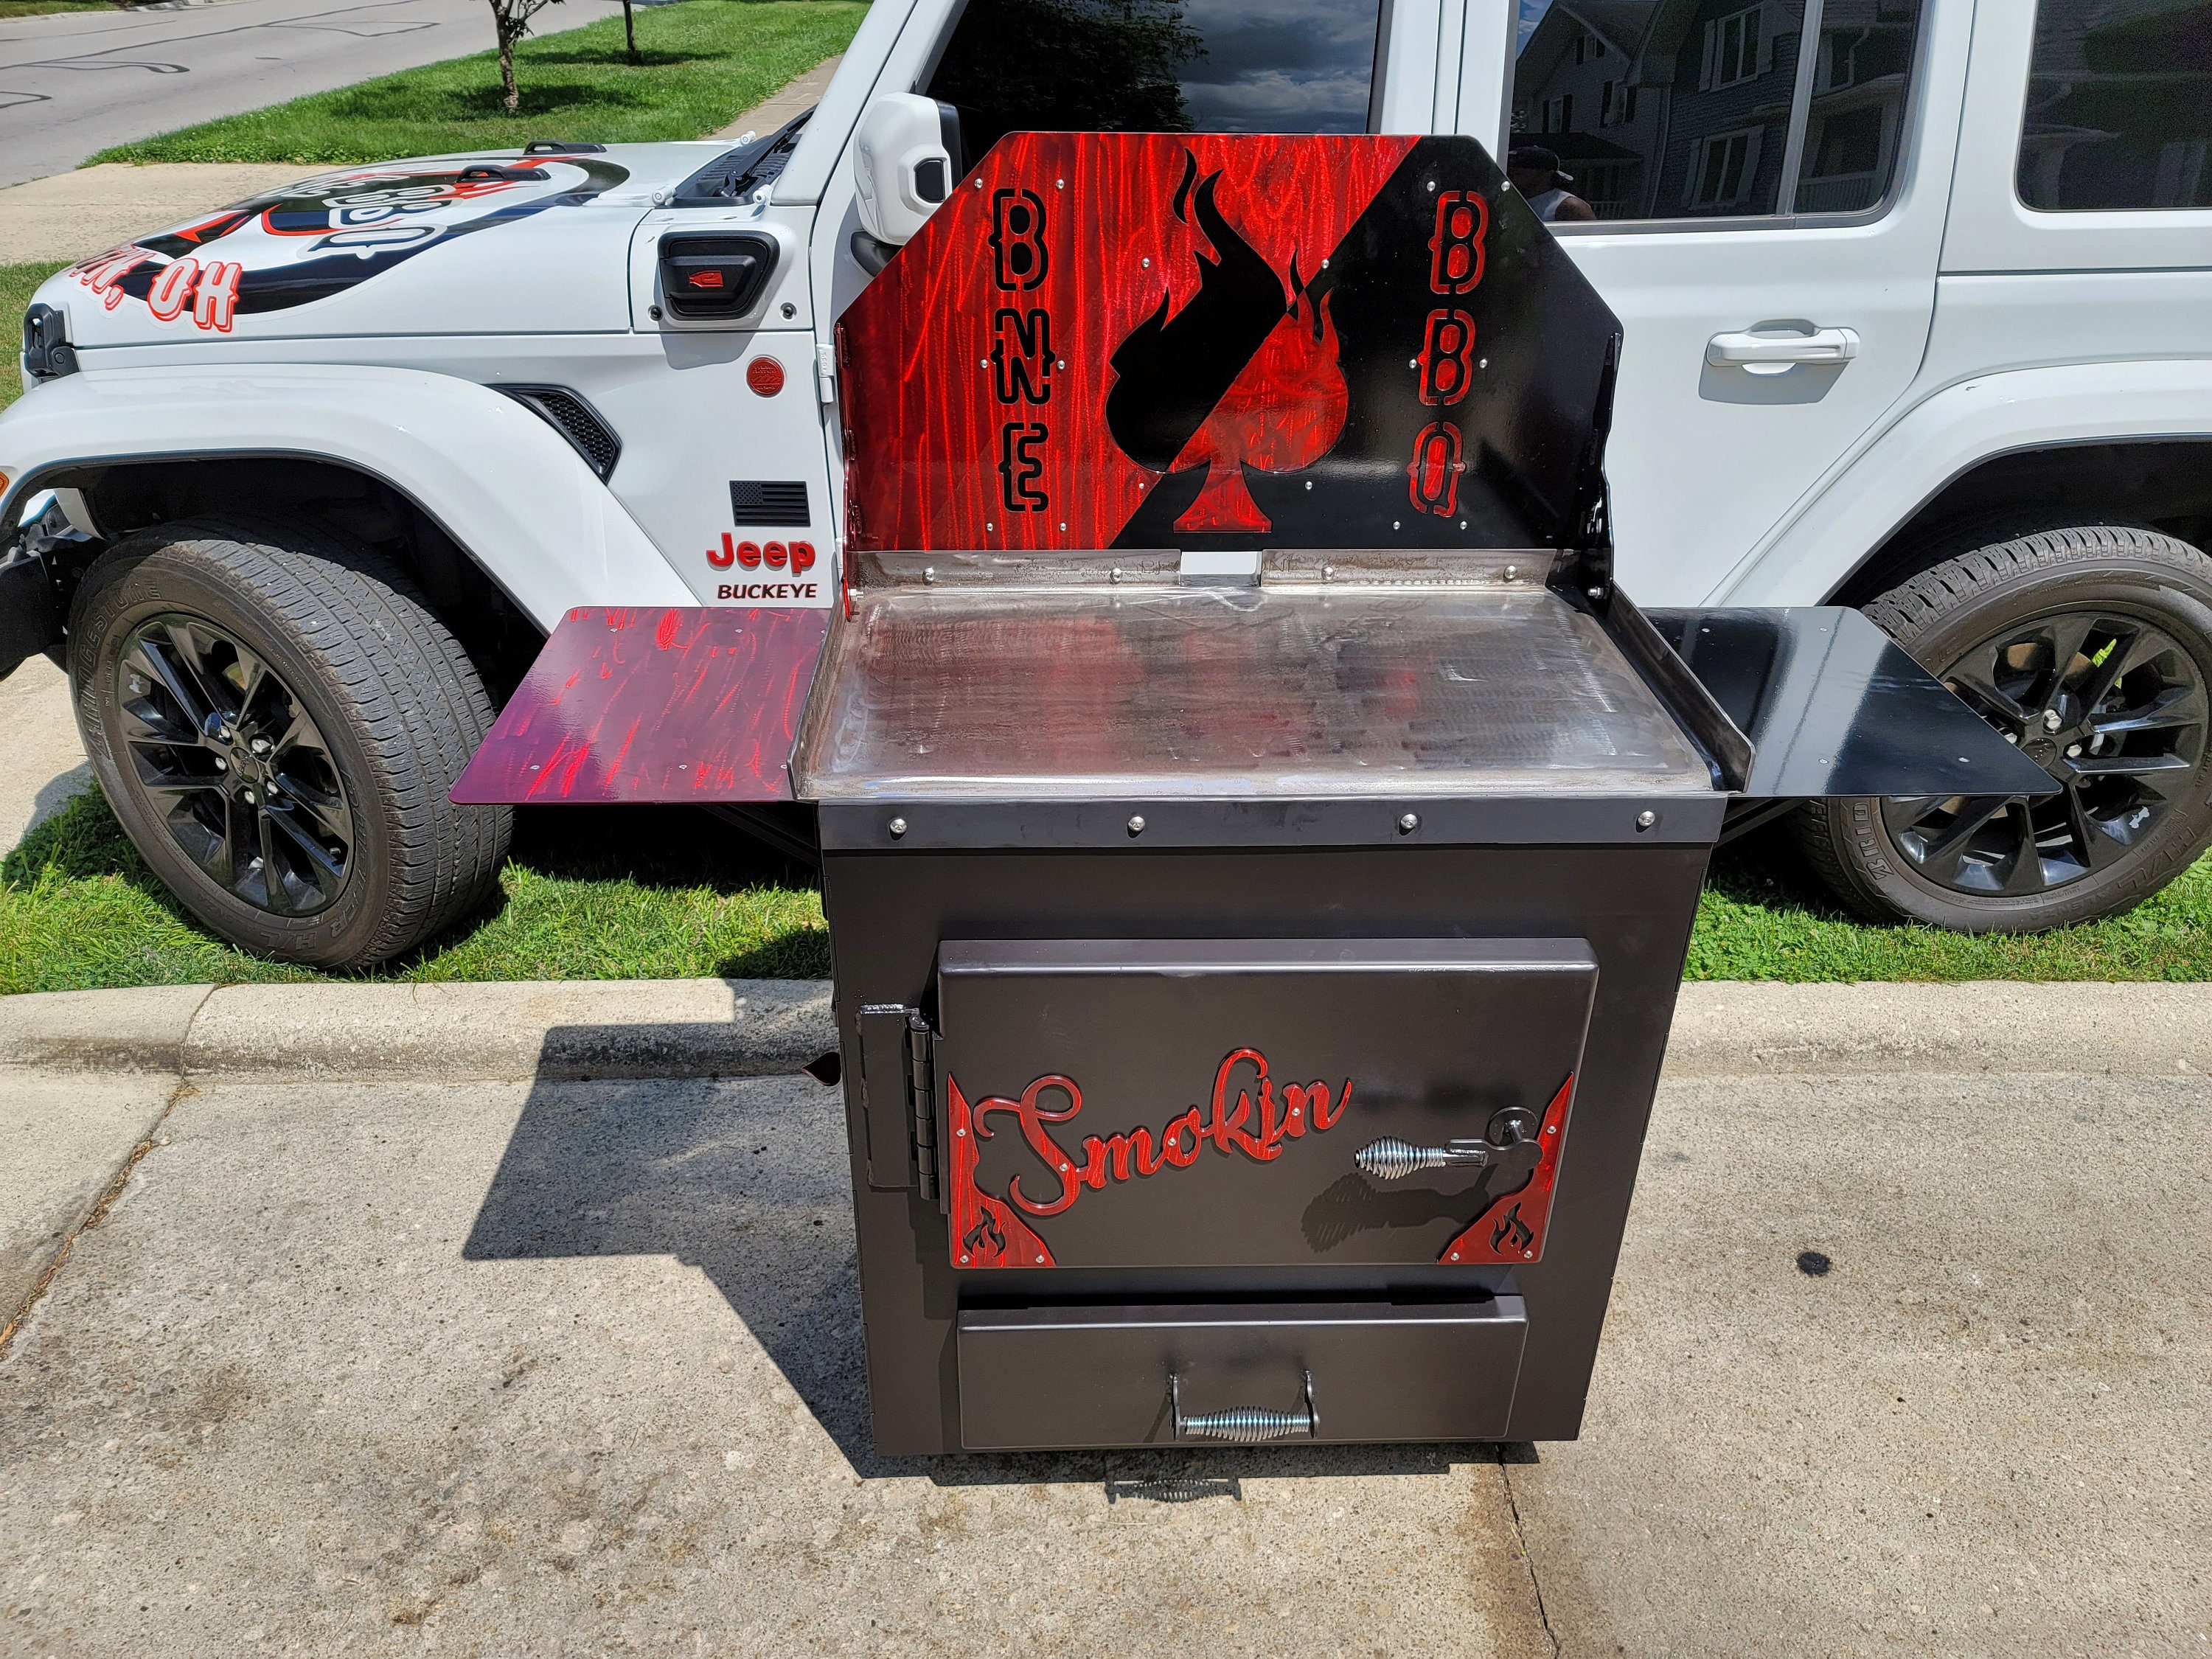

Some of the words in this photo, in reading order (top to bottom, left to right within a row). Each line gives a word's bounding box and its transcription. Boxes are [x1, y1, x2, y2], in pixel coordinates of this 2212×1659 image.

[147, 258, 242, 333] OH
[1407, 190, 1489, 517] BBQ
[706, 532, 815, 573] Jeep
[717, 583, 818, 599] BUCKEYE
[973, 1048, 1352, 1216] Smokin
